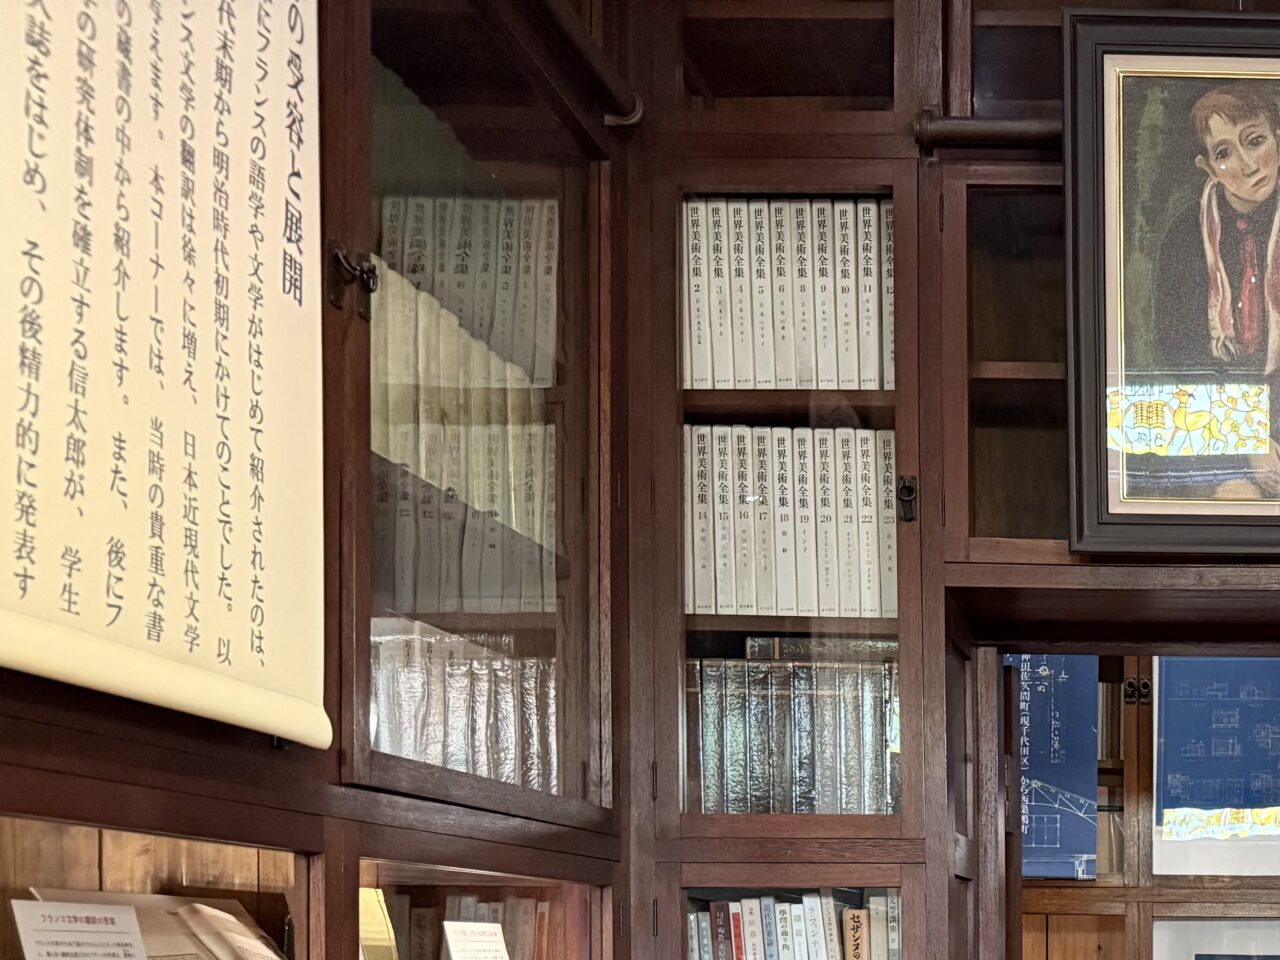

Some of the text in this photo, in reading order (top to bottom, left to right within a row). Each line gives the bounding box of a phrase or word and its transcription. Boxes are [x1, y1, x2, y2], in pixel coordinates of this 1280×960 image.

[690, 206, 703, 278] 世界美術全集
[711, 206, 724, 279] 世界美術全集
[733, 206, 745, 279] 世界美術全集
[754, 208, 766, 280] 世界美術全集
[774, 206, 787, 278] 世界美術全集
[795, 207, 808, 279] 世界美術全集
[817, 206, 829, 278] 世界美術全集
[839, 209, 851, 280] 世界美術全集
[862, 206, 873, 278] 世界美術全集
[59, 0, 98, 616] の研究体制を確立する信太郎が、学生
[696, 433, 708, 505] 世界美術全集
[717, 434, 729, 506] 世界美術全集
[736, 434, 748, 505] 世界美術全集
[756, 434, 768, 507] 世界美術全集
[777, 436, 789, 508] 世界美術全集
[797, 437, 809, 509] 世界美術全集
[818, 437, 831, 508] 世界美術全集
[841, 438, 853, 509] 世界美術全集
[860, 437, 872, 508] 世界美術全集
[882, 438, 895, 510] 世界美術全集
